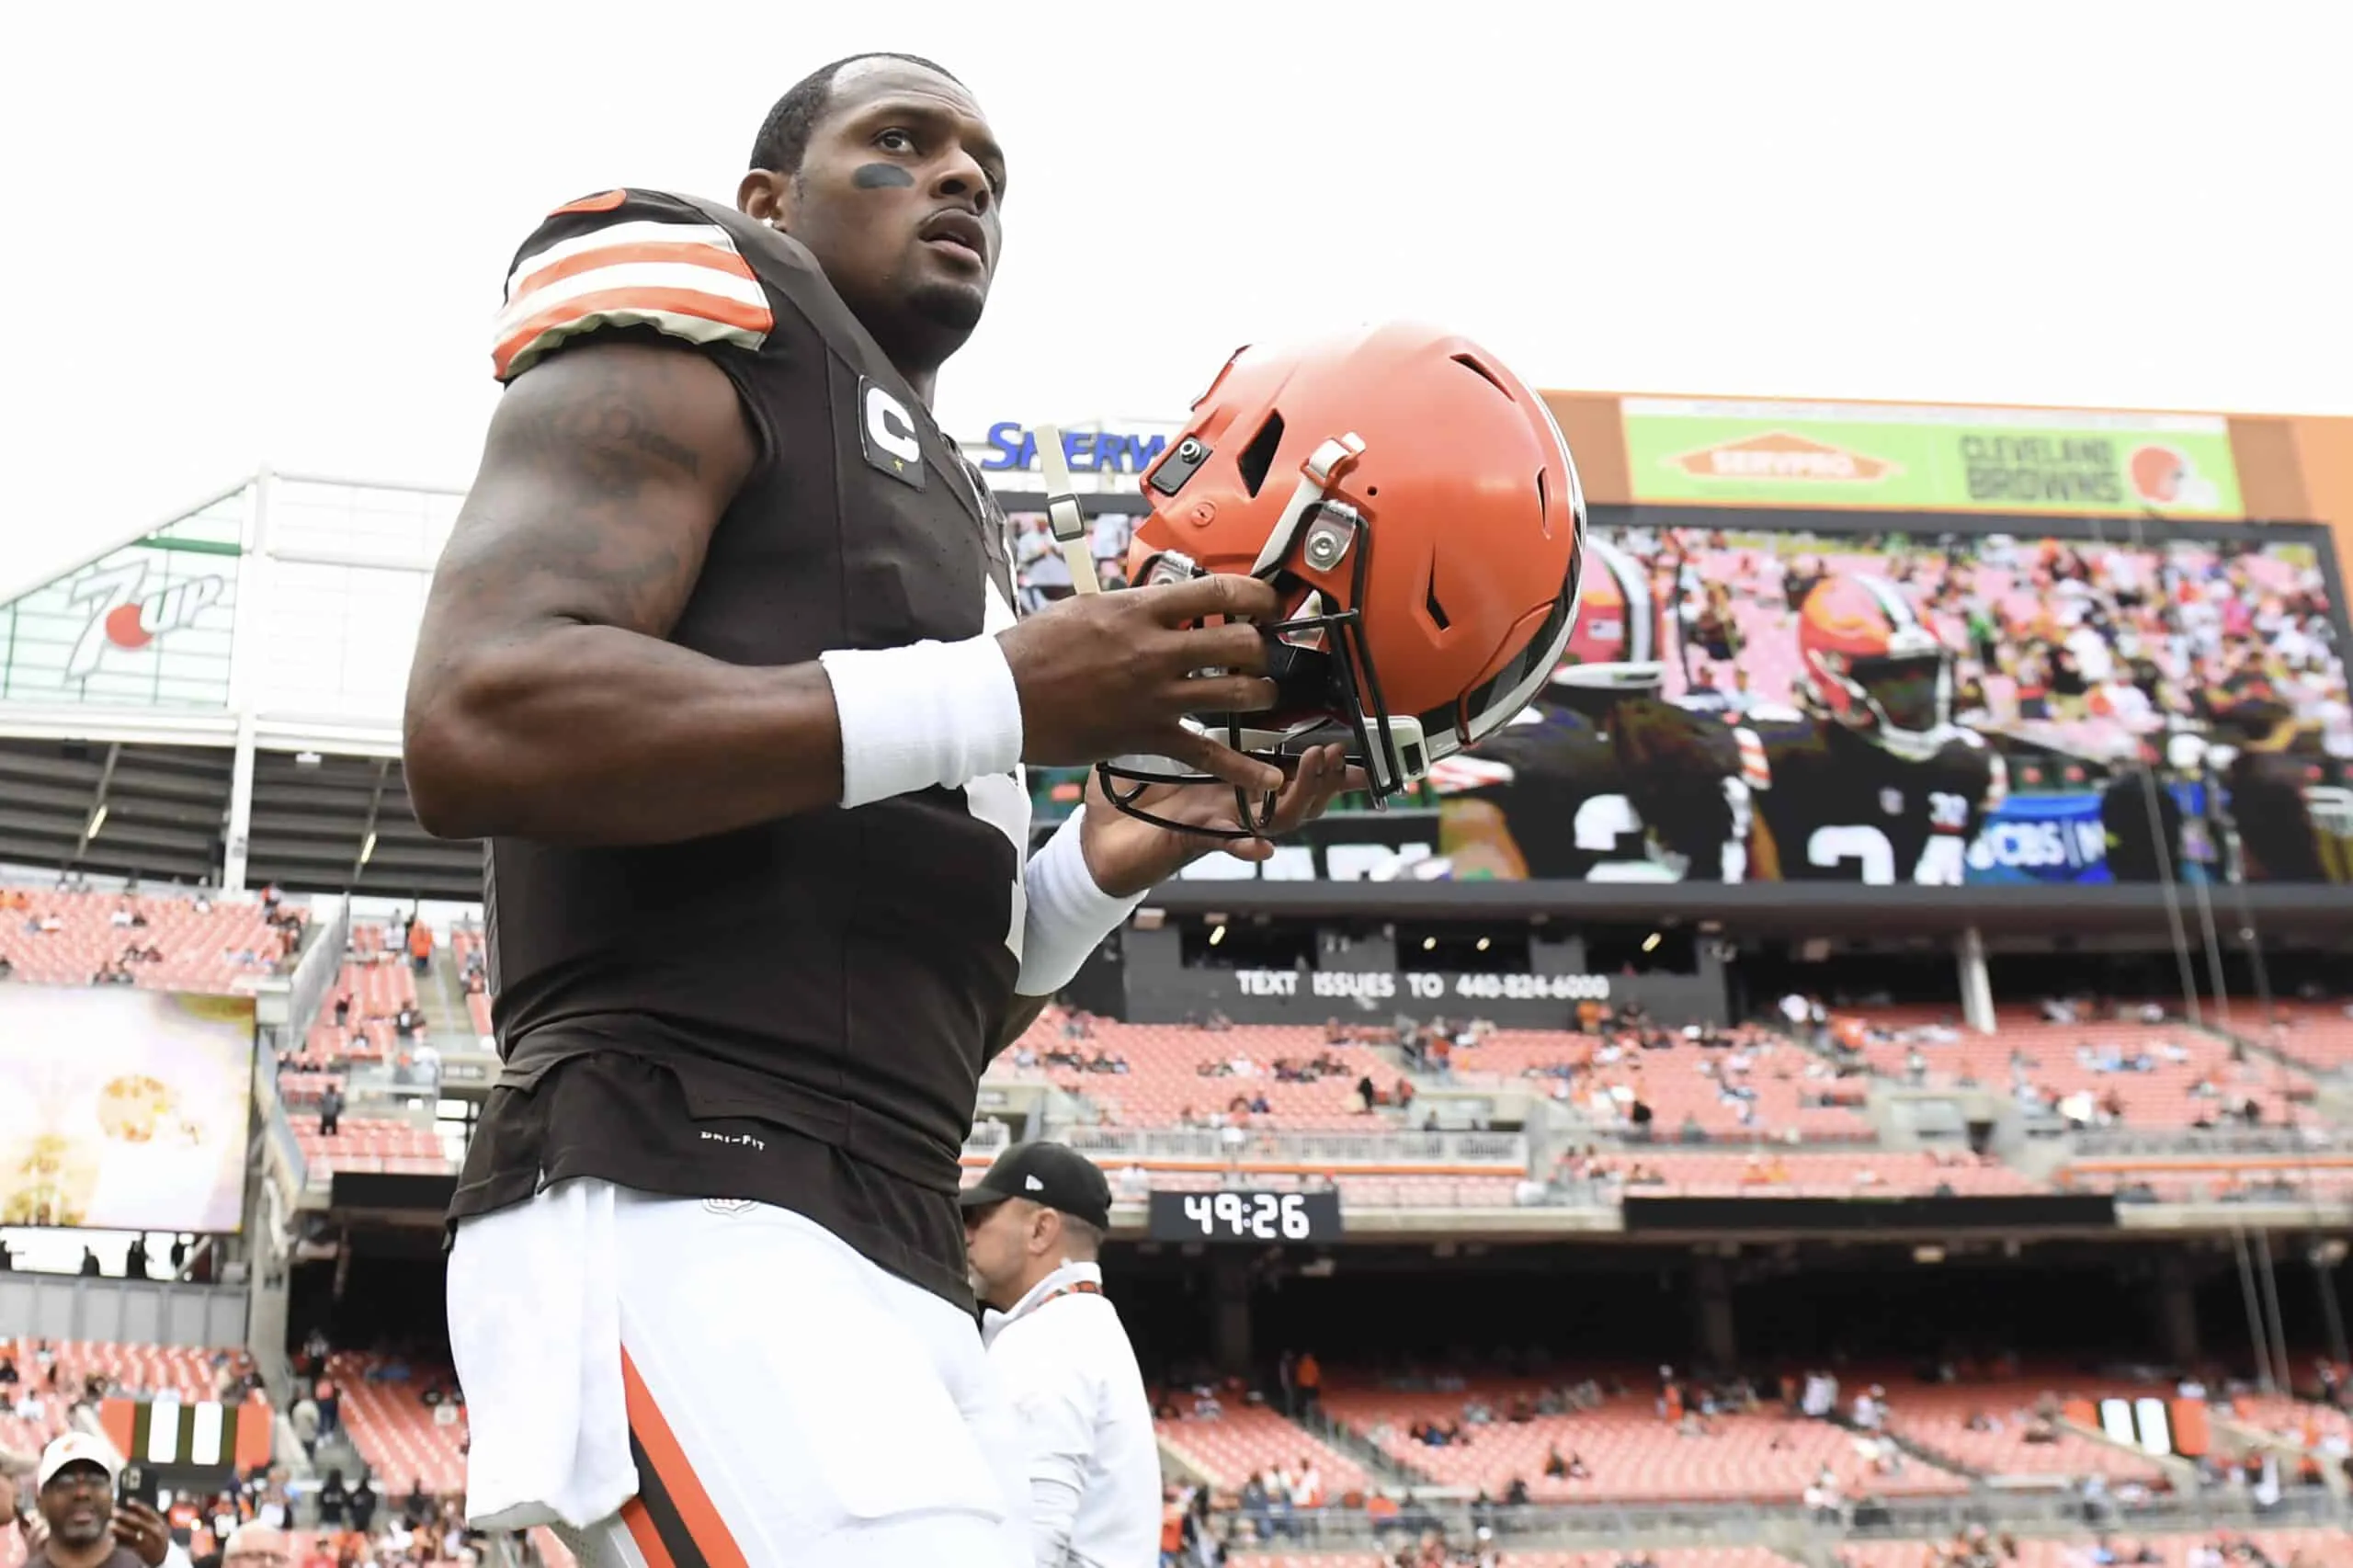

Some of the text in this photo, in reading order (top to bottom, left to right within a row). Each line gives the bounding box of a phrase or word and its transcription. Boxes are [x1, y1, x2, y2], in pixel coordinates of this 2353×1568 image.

[866, 387, 920, 463] C
[1235, 970, 1299, 995] TEXT
[1313, 971, 1396, 998] ISSUES
[1406, 972, 1445, 998] TO
[1184, 1193, 1310, 1239] 49:26
